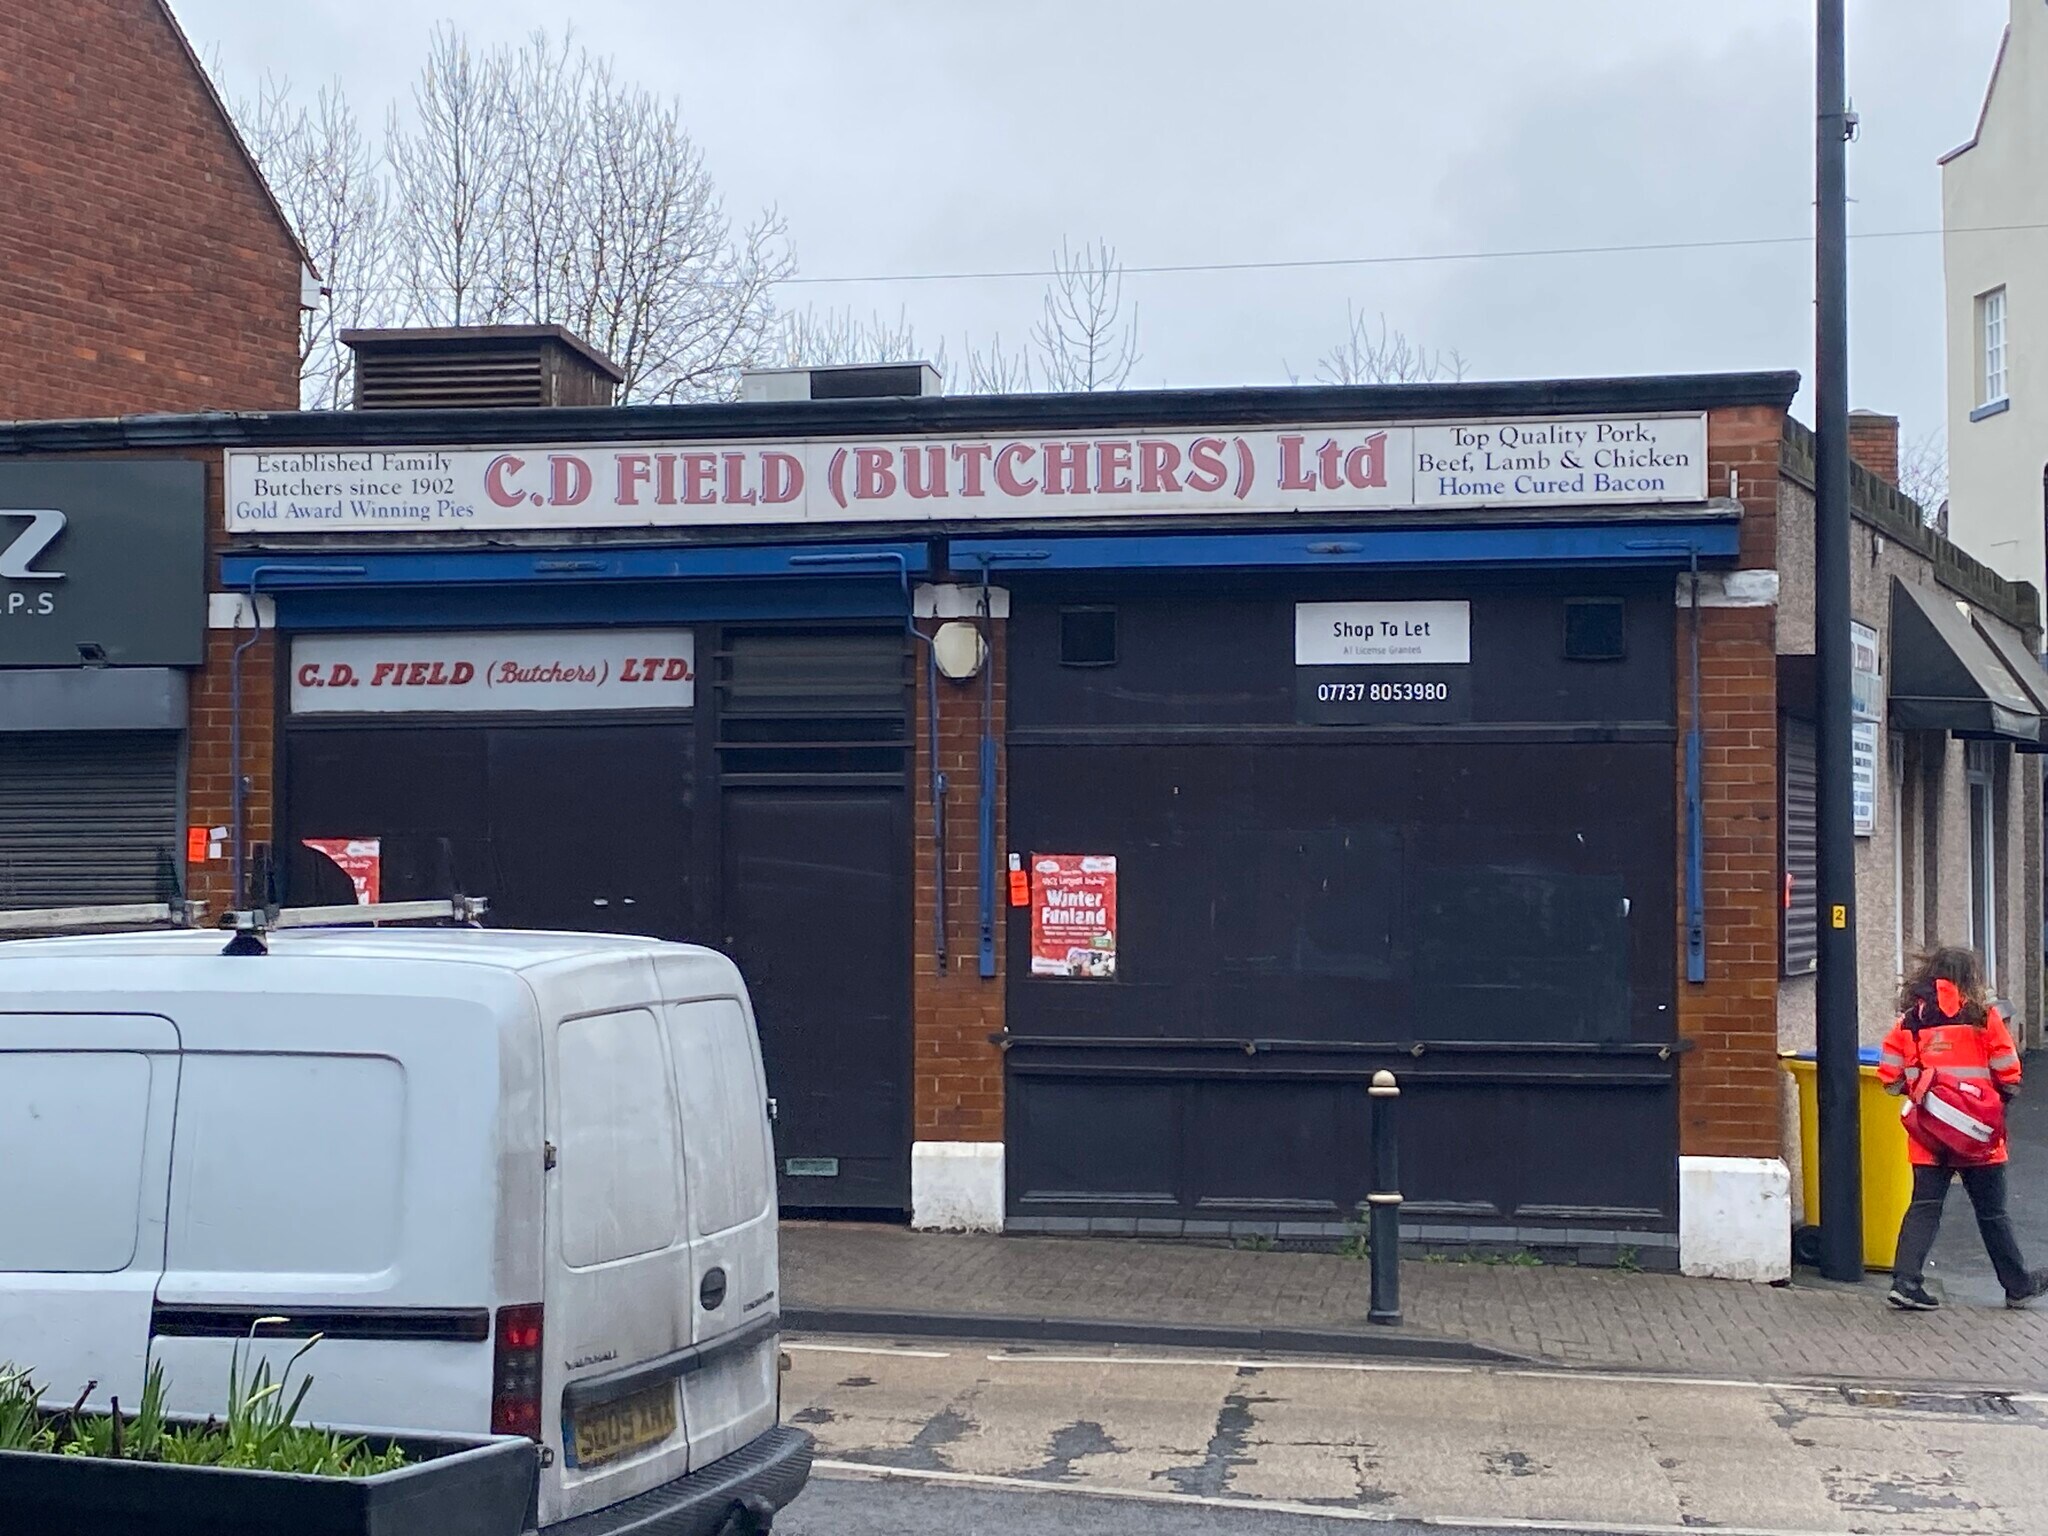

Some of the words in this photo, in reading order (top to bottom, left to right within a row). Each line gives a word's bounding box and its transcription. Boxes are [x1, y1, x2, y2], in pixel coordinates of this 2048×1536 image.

[1450, 427, 1489, 449] Top
[1500, 425, 1587, 448] Quality
[1596, 422, 1656, 443] Pork,
[257, 453, 372, 473] Established
[383, 452, 452, 474] Family
[484, 453, 592, 508] C.D
[614, 451, 804, 506] FIELD
[828, 434, 1254, 509] (BUTCHERS)
[1277, 430, 1387, 491] Ltd
[1418, 452, 1474, 473] Beef,
[1486, 450, 1550, 471] Lamb
[1560, 449, 1584, 469] &
[1594, 446, 1689, 468] Chicken
[254, 478, 342, 496] Butchers
[350, 479, 402, 495] since
[411, 478, 455, 494] 1902
[1438, 476, 1505, 496] Home
[1514, 473, 1584, 494] Cured
[1594, 473, 1665, 492] Bacon
[236, 501, 277, 519] Gold
[285, 500, 342, 518] Award
[351, 500, 430, 521] Winning
[437, 500, 474, 518] Pies
[1333, 621, 1374, 641] Shop
[1405, 620, 1431, 637] Let
[1388, 645, 1422, 656] Granted
[298, 663, 358, 687] C.D.
[370, 661, 475, 685] FIELD
[486, 659, 608, 688] (Butchers)
[619, 657, 695, 682] LTD.
[1317, 683, 1366, 701] 07737
[1370, 682, 1448, 701] 8053980
[1046, 888, 1103, 907] Winter
[1041, 906, 1106, 925] Funland
[1835, 908, 1844, 921] 2
